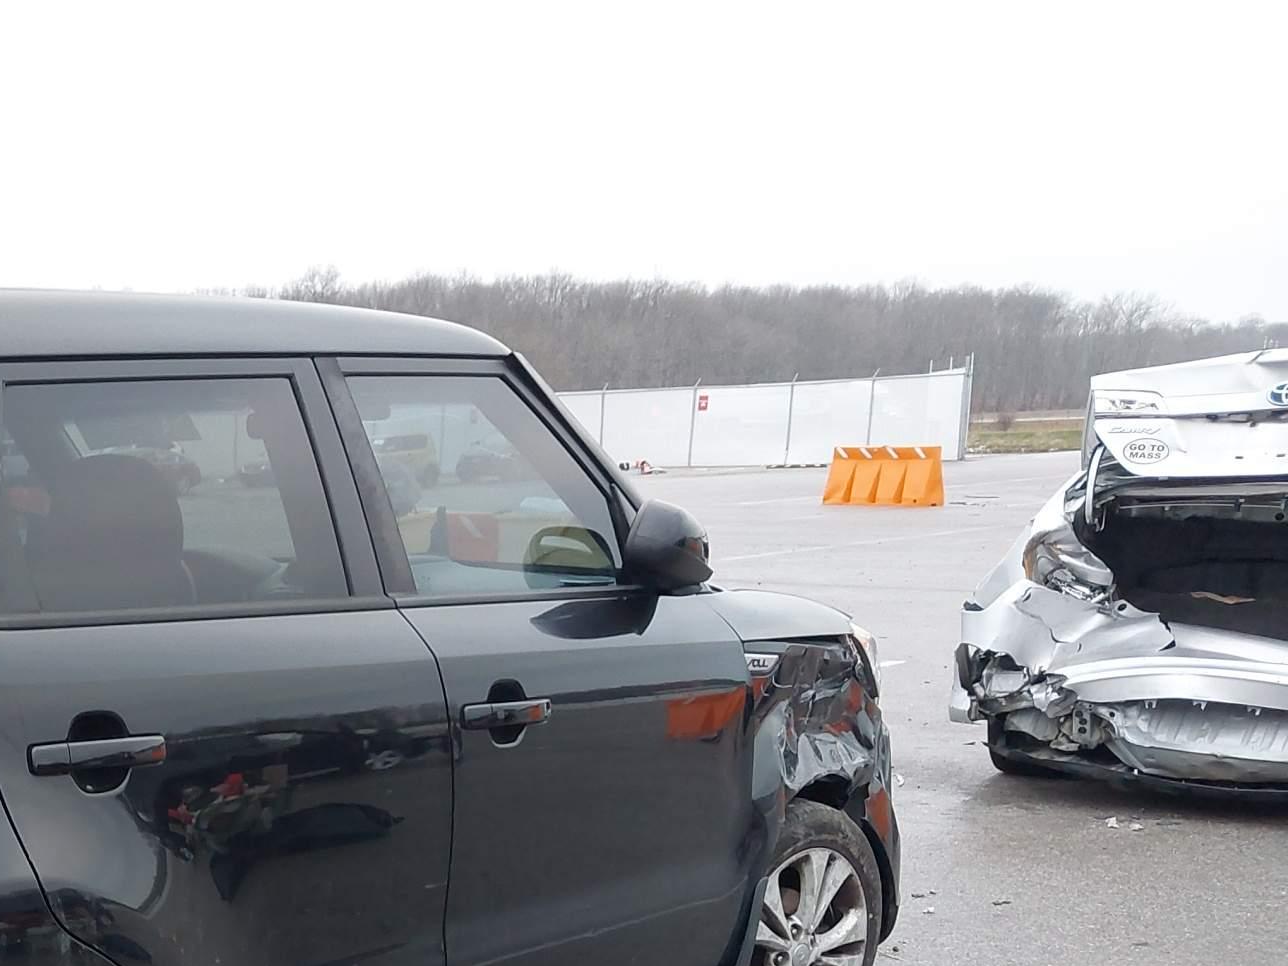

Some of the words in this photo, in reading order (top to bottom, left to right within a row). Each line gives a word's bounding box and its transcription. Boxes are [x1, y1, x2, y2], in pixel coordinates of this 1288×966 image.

[1129, 443, 1146, 452] GO
[1151, 444, 1165, 452] TO
[1129, 452, 1161, 460] MASS
